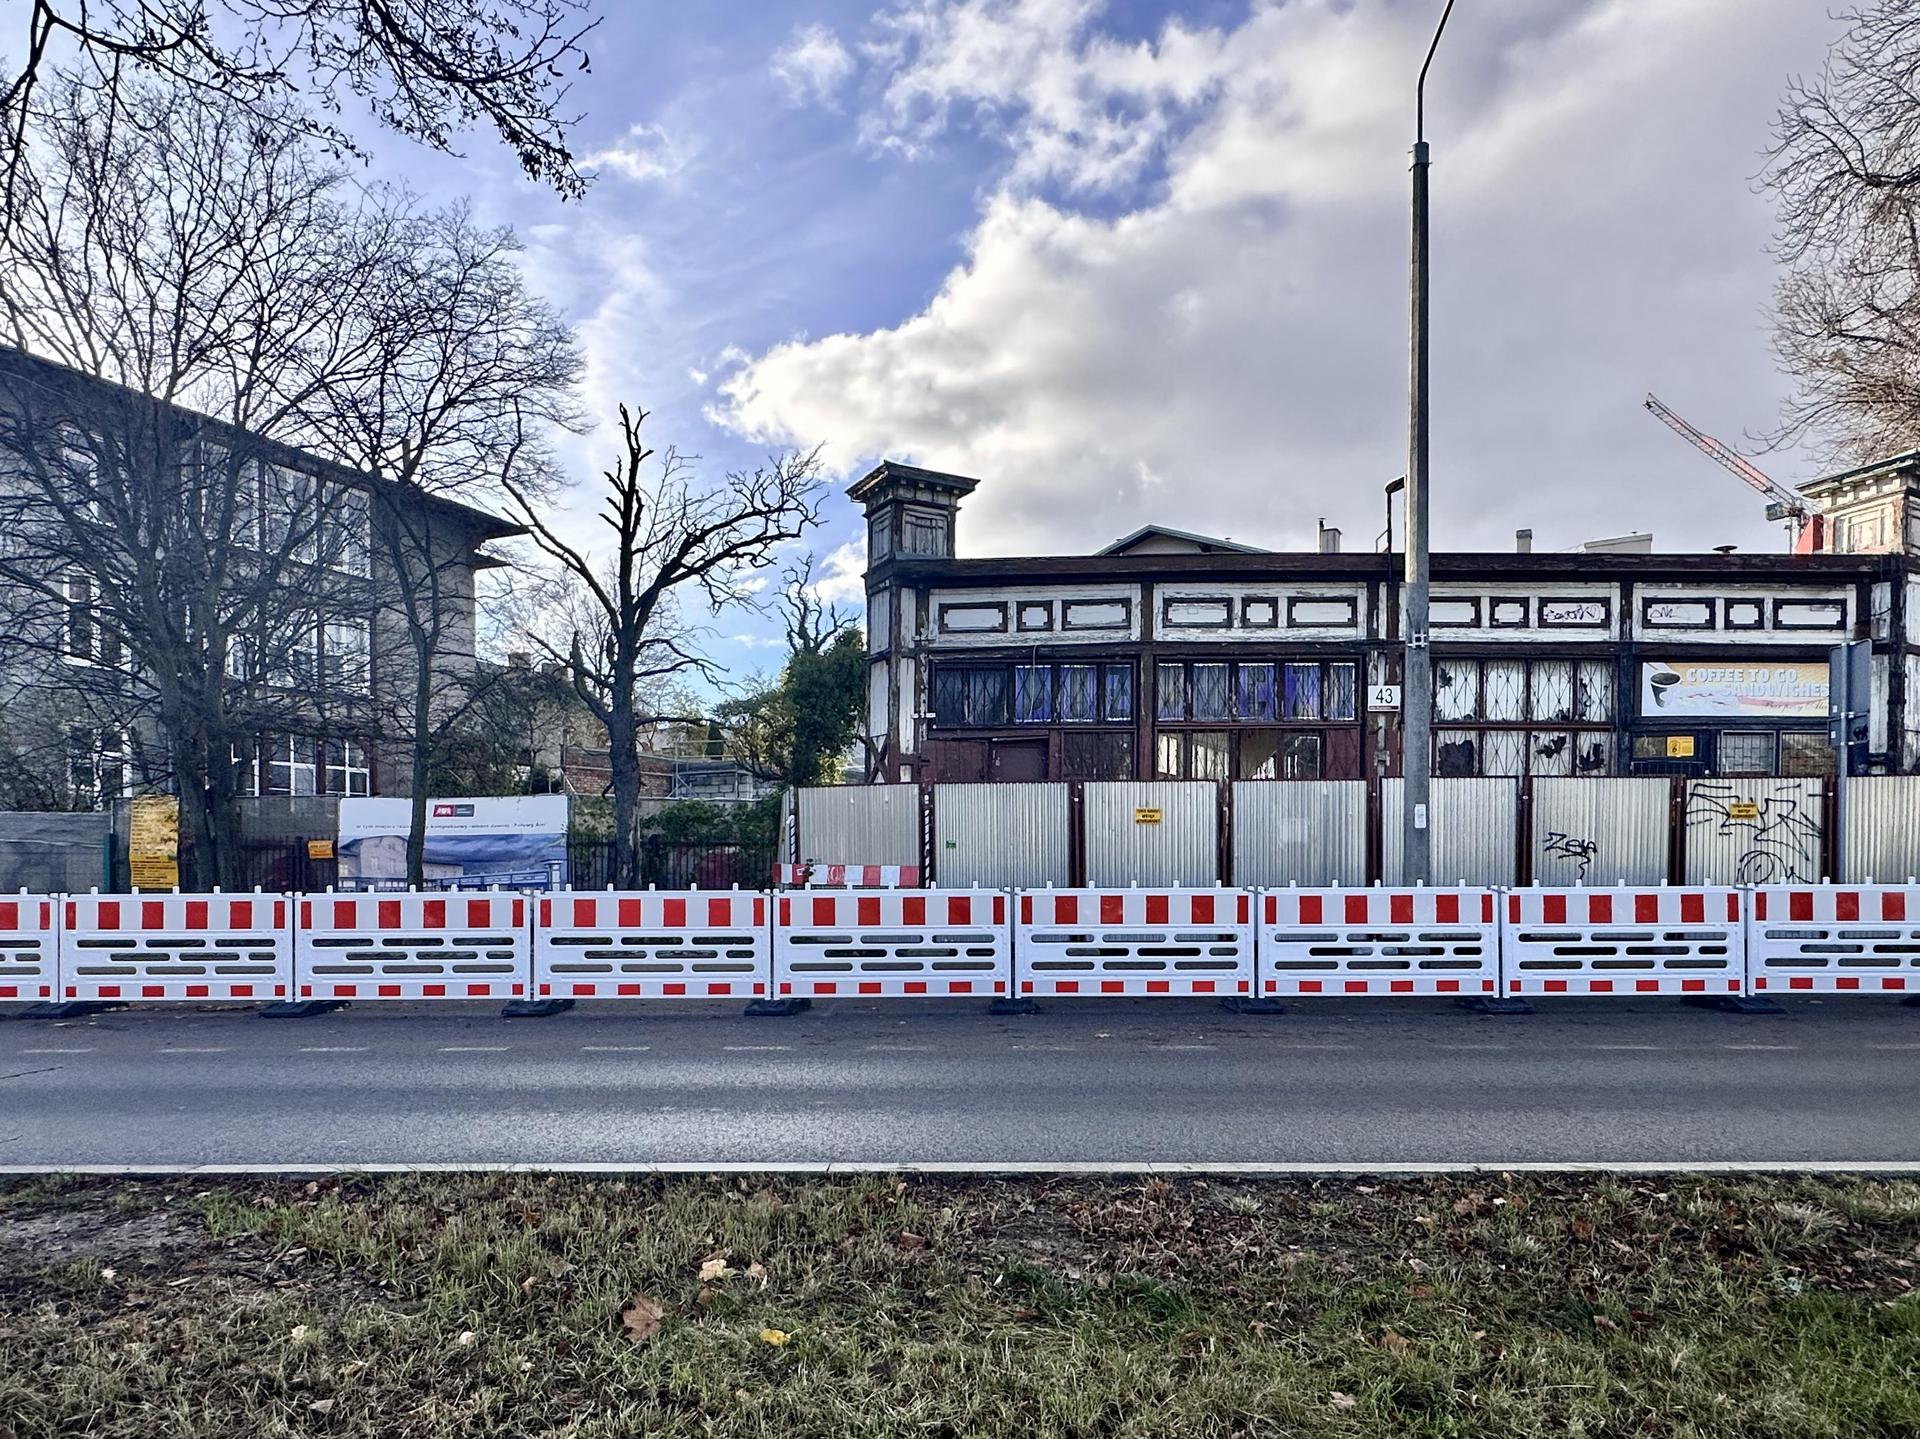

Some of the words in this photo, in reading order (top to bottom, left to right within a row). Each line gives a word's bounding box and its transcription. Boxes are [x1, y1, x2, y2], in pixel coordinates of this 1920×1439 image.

[1686, 668, 1744, 683] COFFEE
[1750, 668, 1771, 683] TO
[1775, 668, 1798, 683] GO
[1375, 687, 1393, 704] 43
[1720, 683, 1829, 698] SANDWICHES
